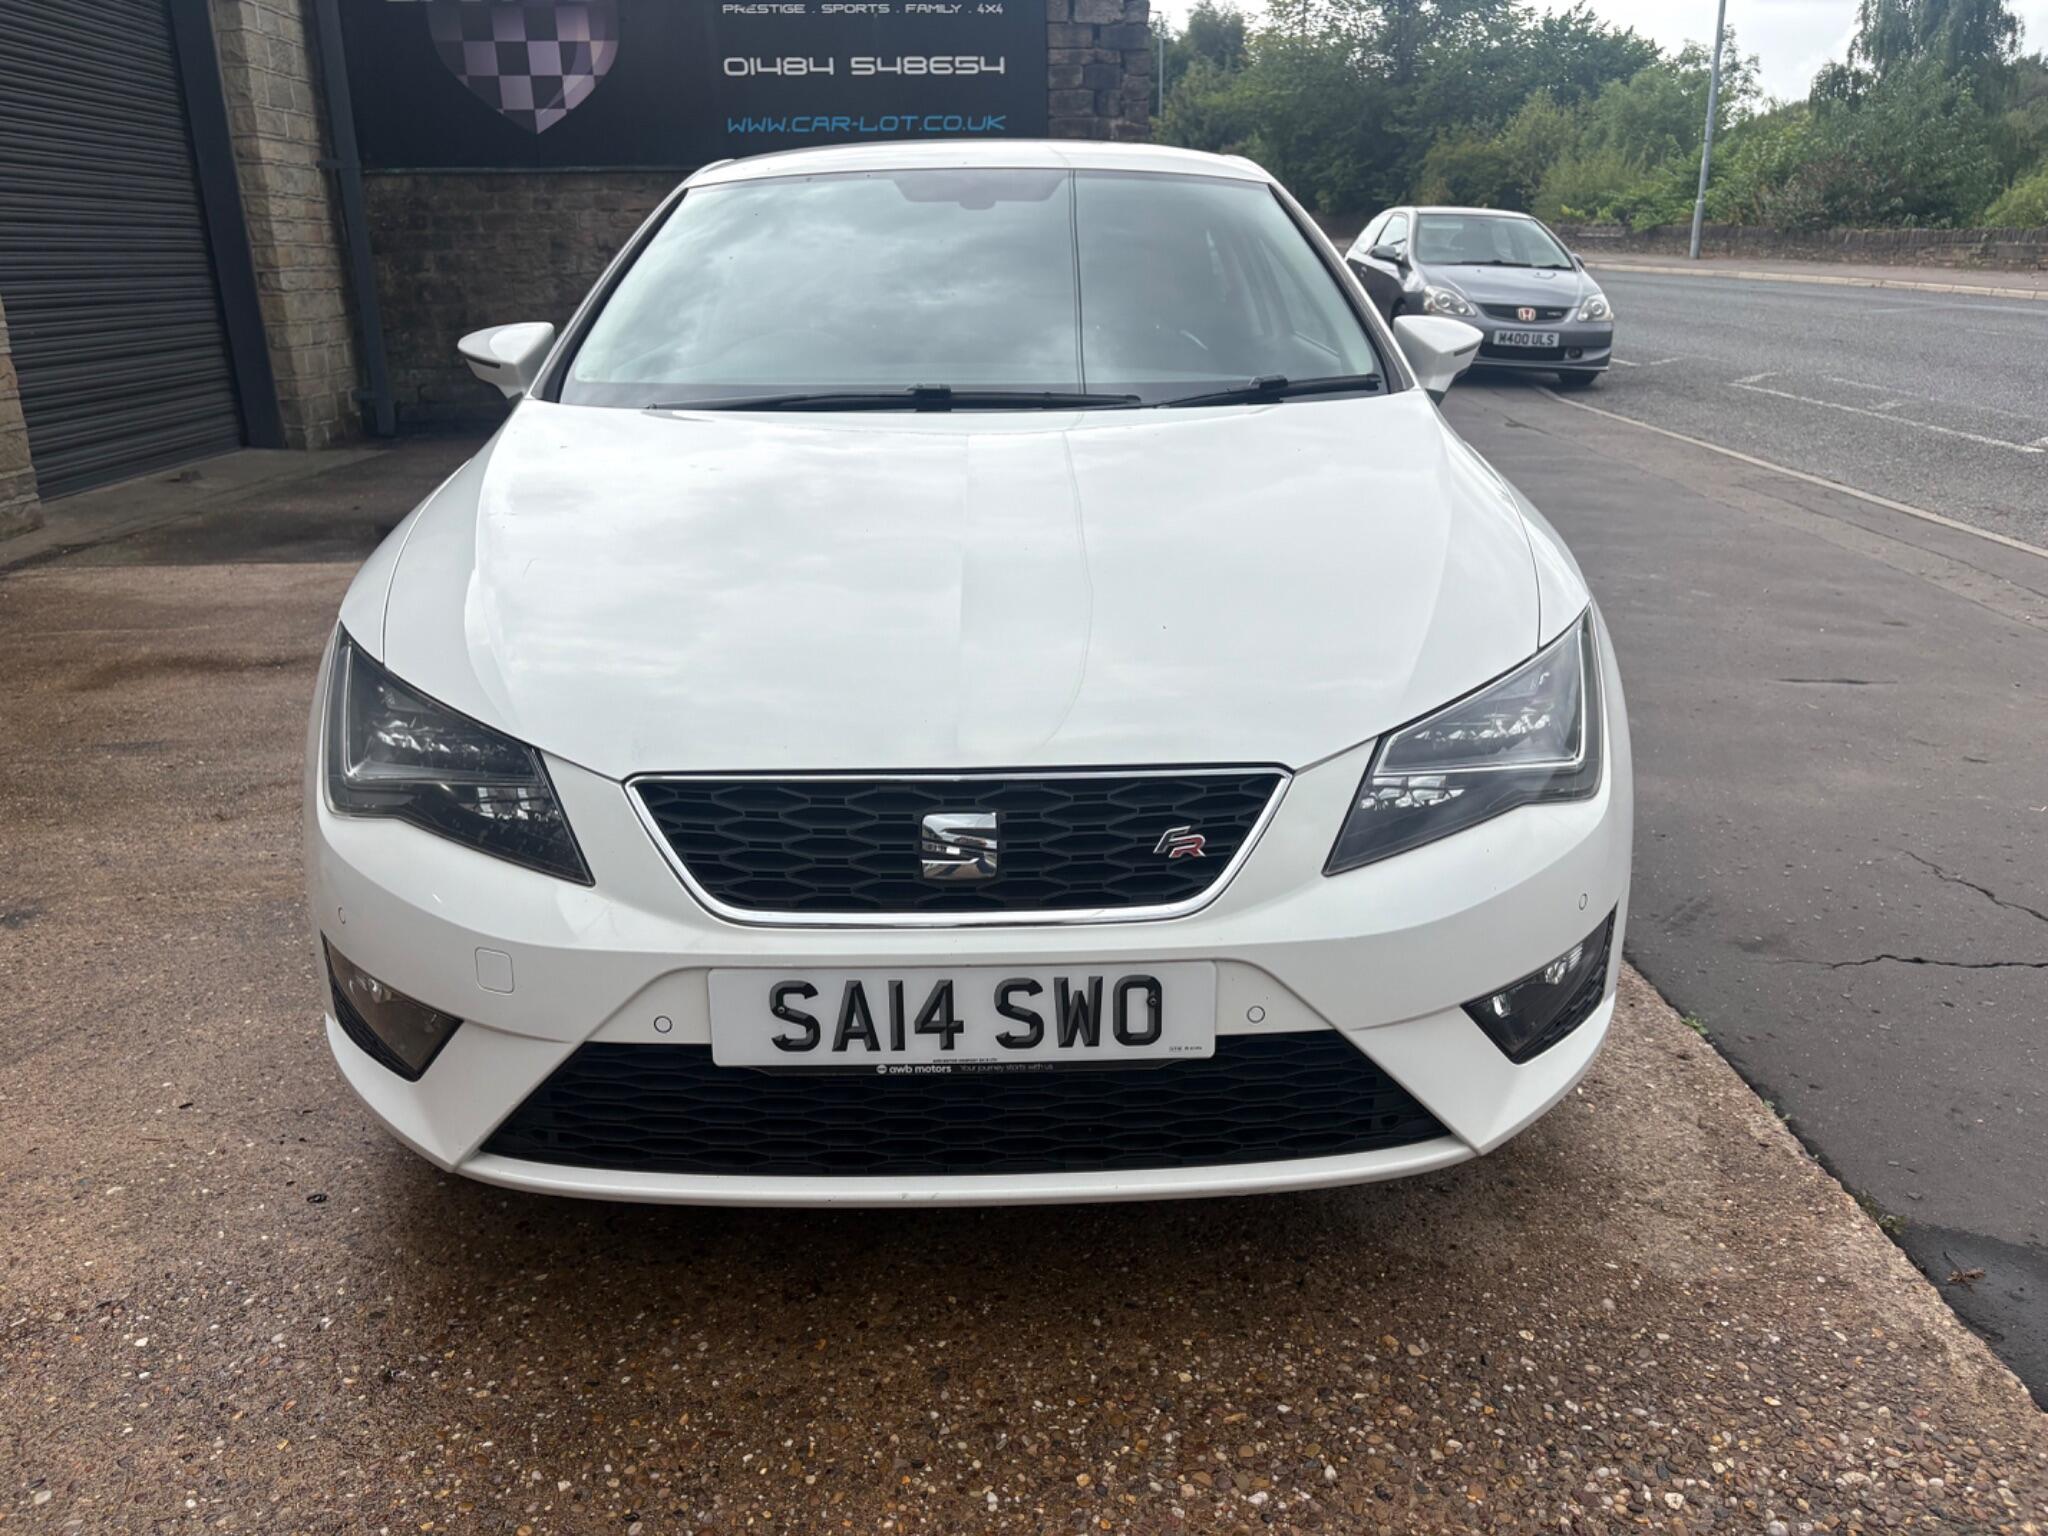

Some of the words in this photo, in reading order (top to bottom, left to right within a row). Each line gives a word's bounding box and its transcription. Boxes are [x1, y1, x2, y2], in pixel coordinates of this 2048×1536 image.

[722, 3, 806, 14] PRESTIGE
[821, 3, 890, 14] SPORTS
[904, 3, 962, 14] FAMILY
[723, 56, 834, 76] 01484
[850, 56, 1005, 75] 548654
[727, 115, 1007, 133] WWW.CAR-LOT.CO.UK
[1531, 334, 1554, 346] ULS
[1153, 825, 1206, 858] FR
[769, 979, 964, 1052] SA14
[994, 974, 1163, 1050] SWO
[889, 1064, 913, 1073] awb
[914, 1064, 952, 1073] motors
